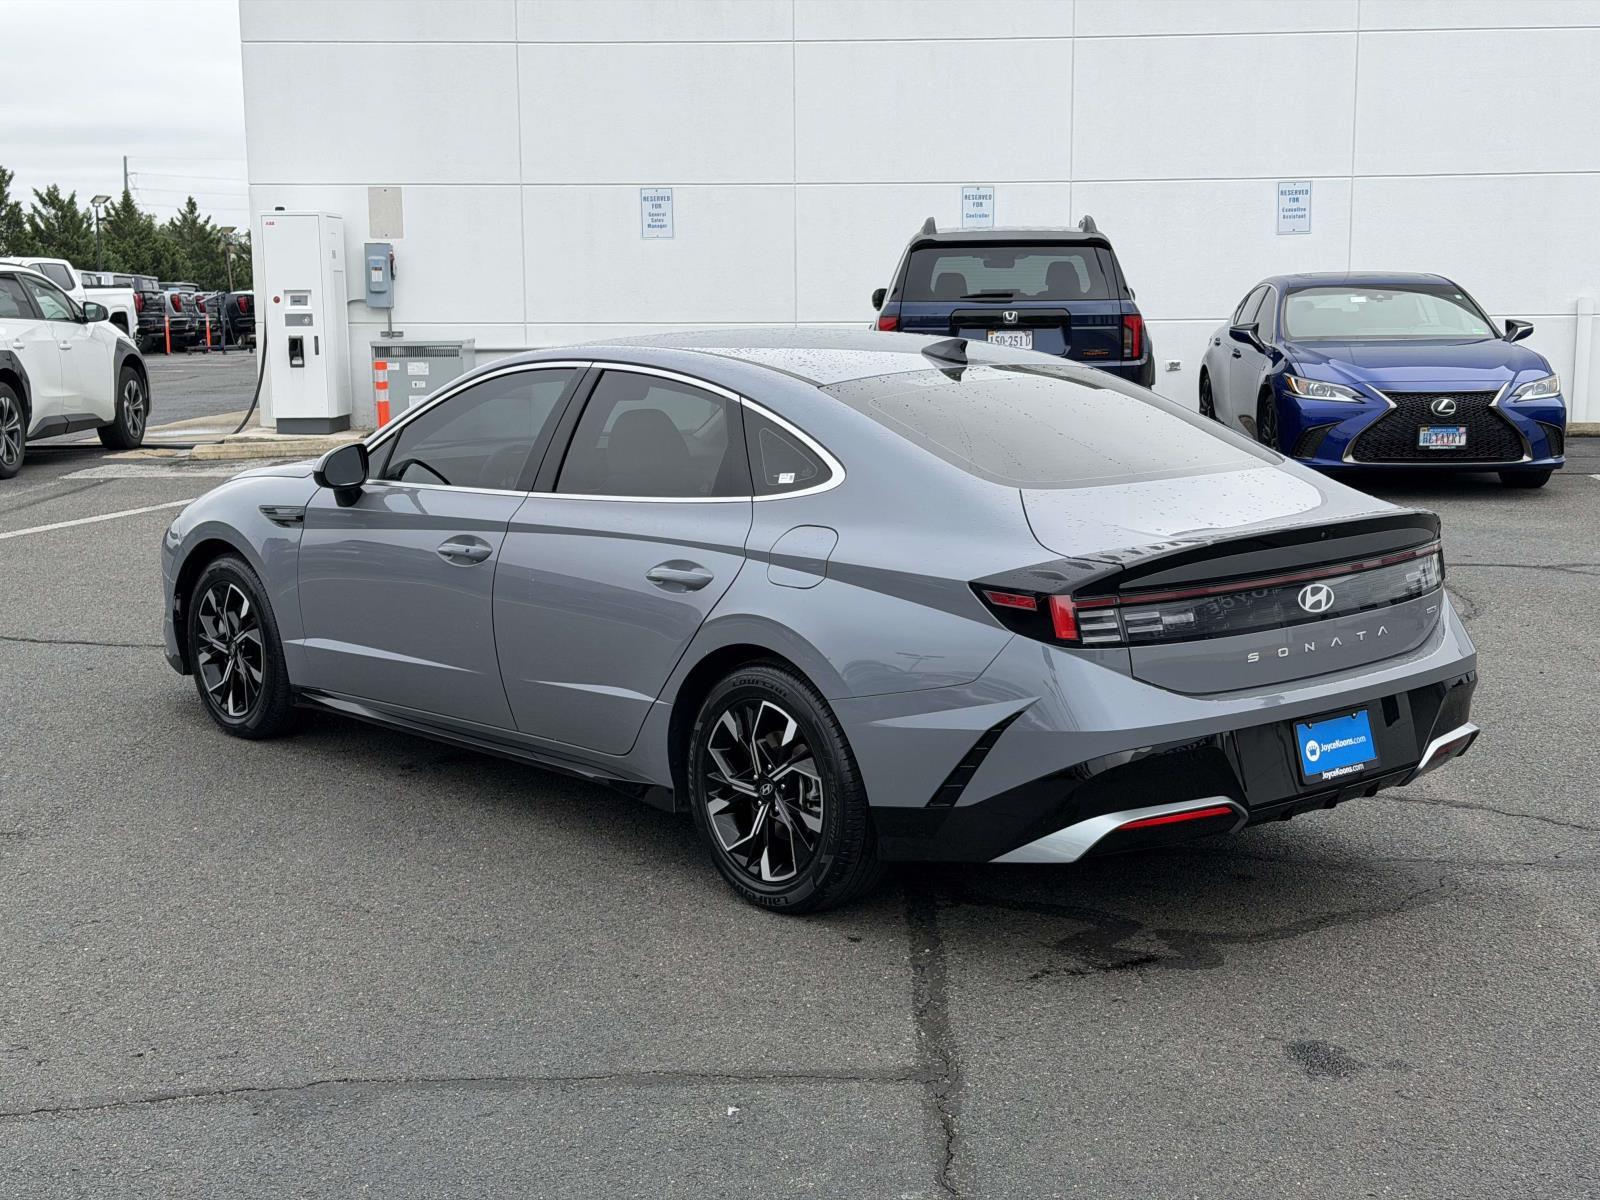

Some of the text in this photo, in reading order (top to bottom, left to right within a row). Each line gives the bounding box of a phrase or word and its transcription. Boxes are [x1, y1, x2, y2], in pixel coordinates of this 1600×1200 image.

[1247, 625, 1389, 663] SONATA
[1321, 735, 1366, 752] JoyceKoons.com
[1322, 763, 1364, 779] JoyceKoons.com
